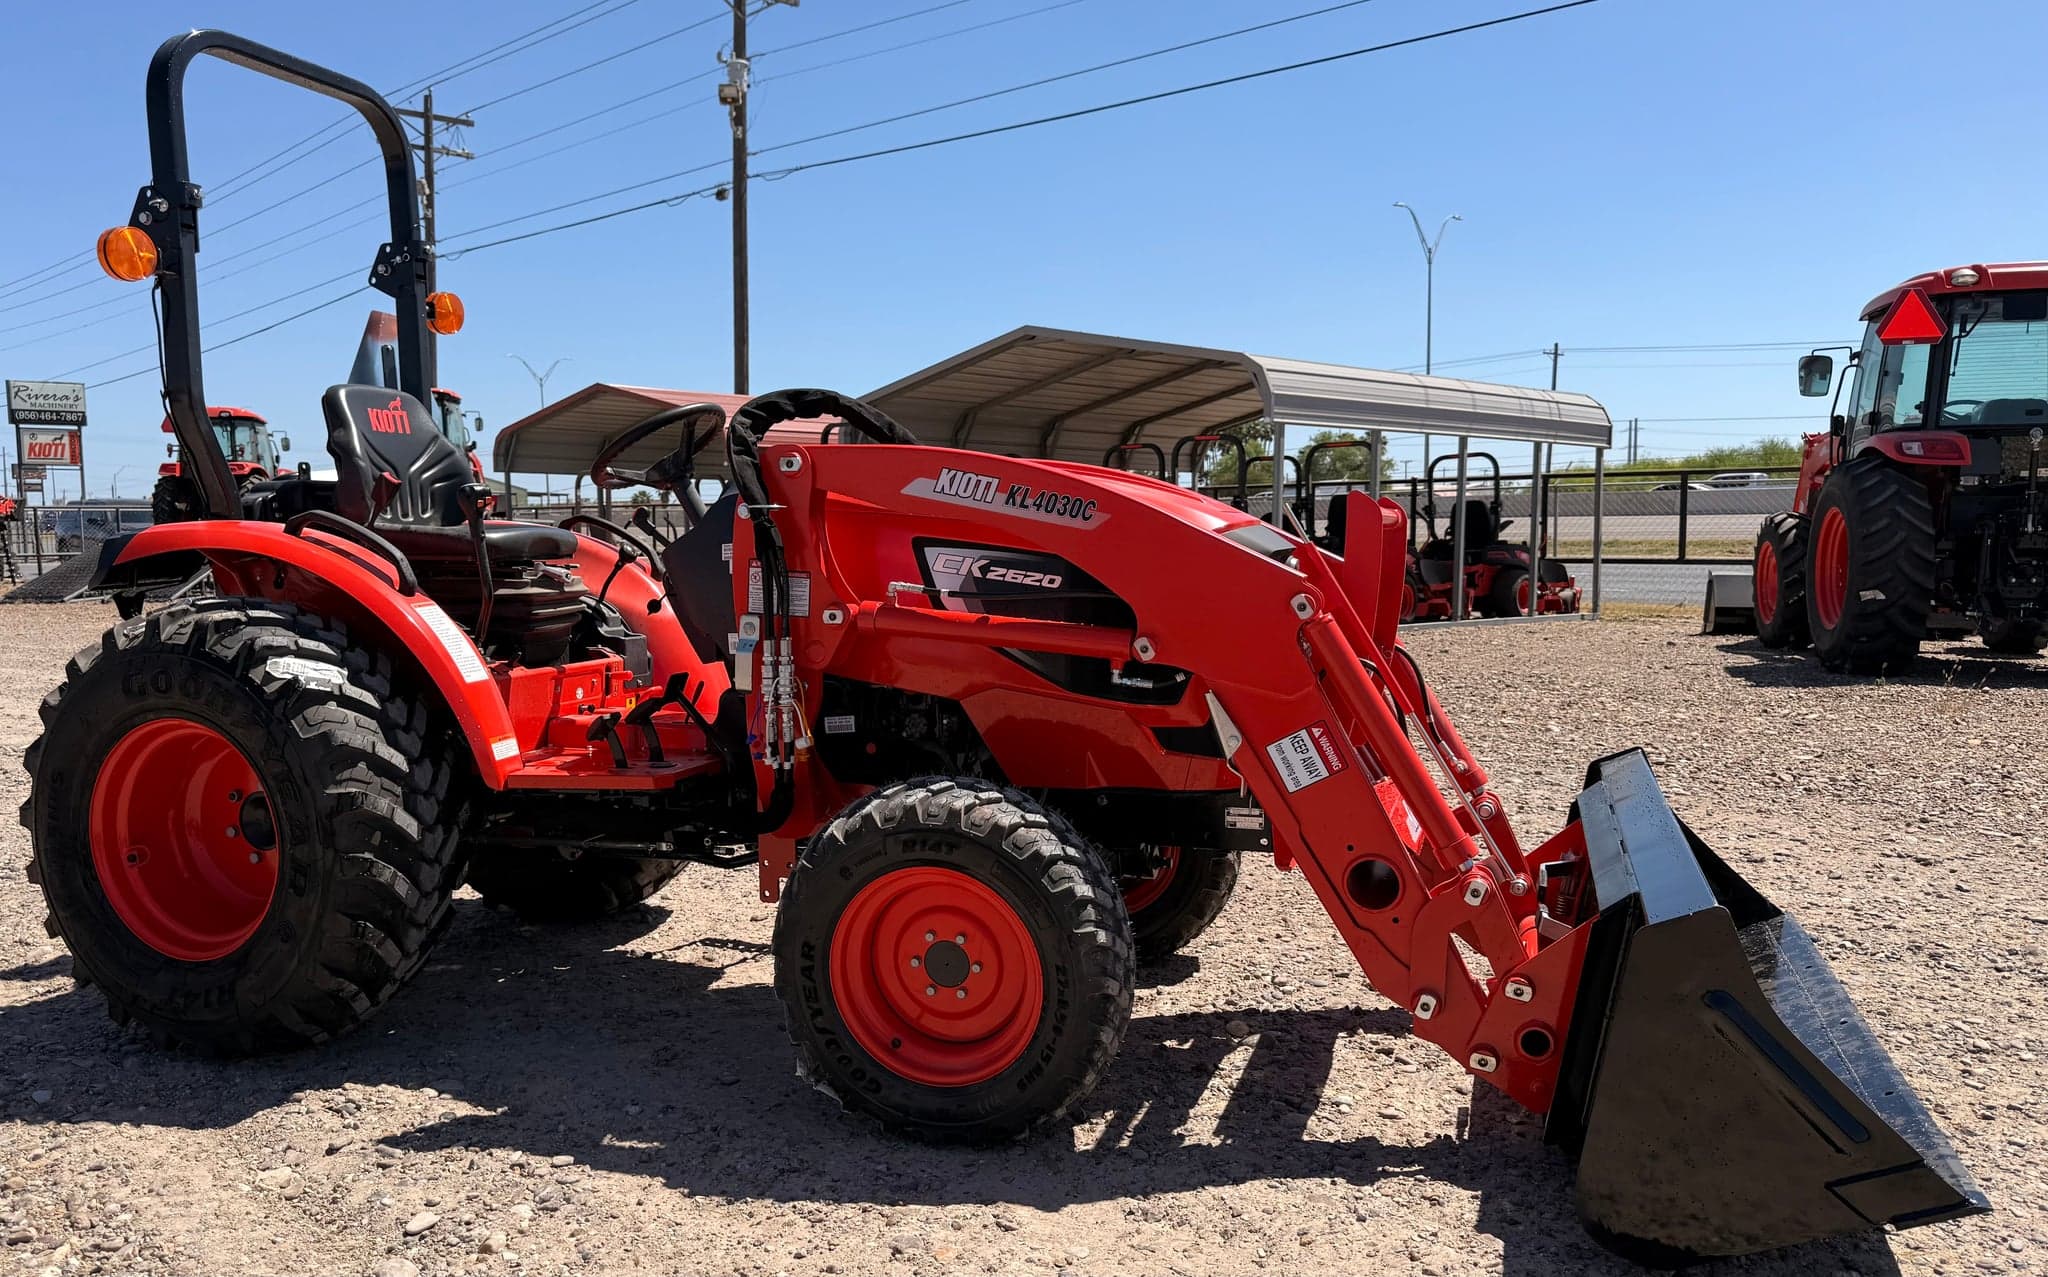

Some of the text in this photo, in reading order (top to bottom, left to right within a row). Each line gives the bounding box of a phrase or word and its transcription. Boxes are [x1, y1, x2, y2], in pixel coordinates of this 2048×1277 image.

[13, 385, 82, 403] Rivera's
[30, 402, 79, 410] MACHINERY
[15, 411, 84, 421] (956)464-7867
[367, 407, 411, 434] KIOTI
[27, 442, 66, 458] KIOTI
[933, 467, 1097, 522] KIOTI KL4030C
[1274, 743, 1303, 789] from working area
[1288, 733, 1323, 780] KEEP AWAY
[1318, 735, 1342, 771] WARNING
[800, 941, 882, 1094] GOODYEAR
